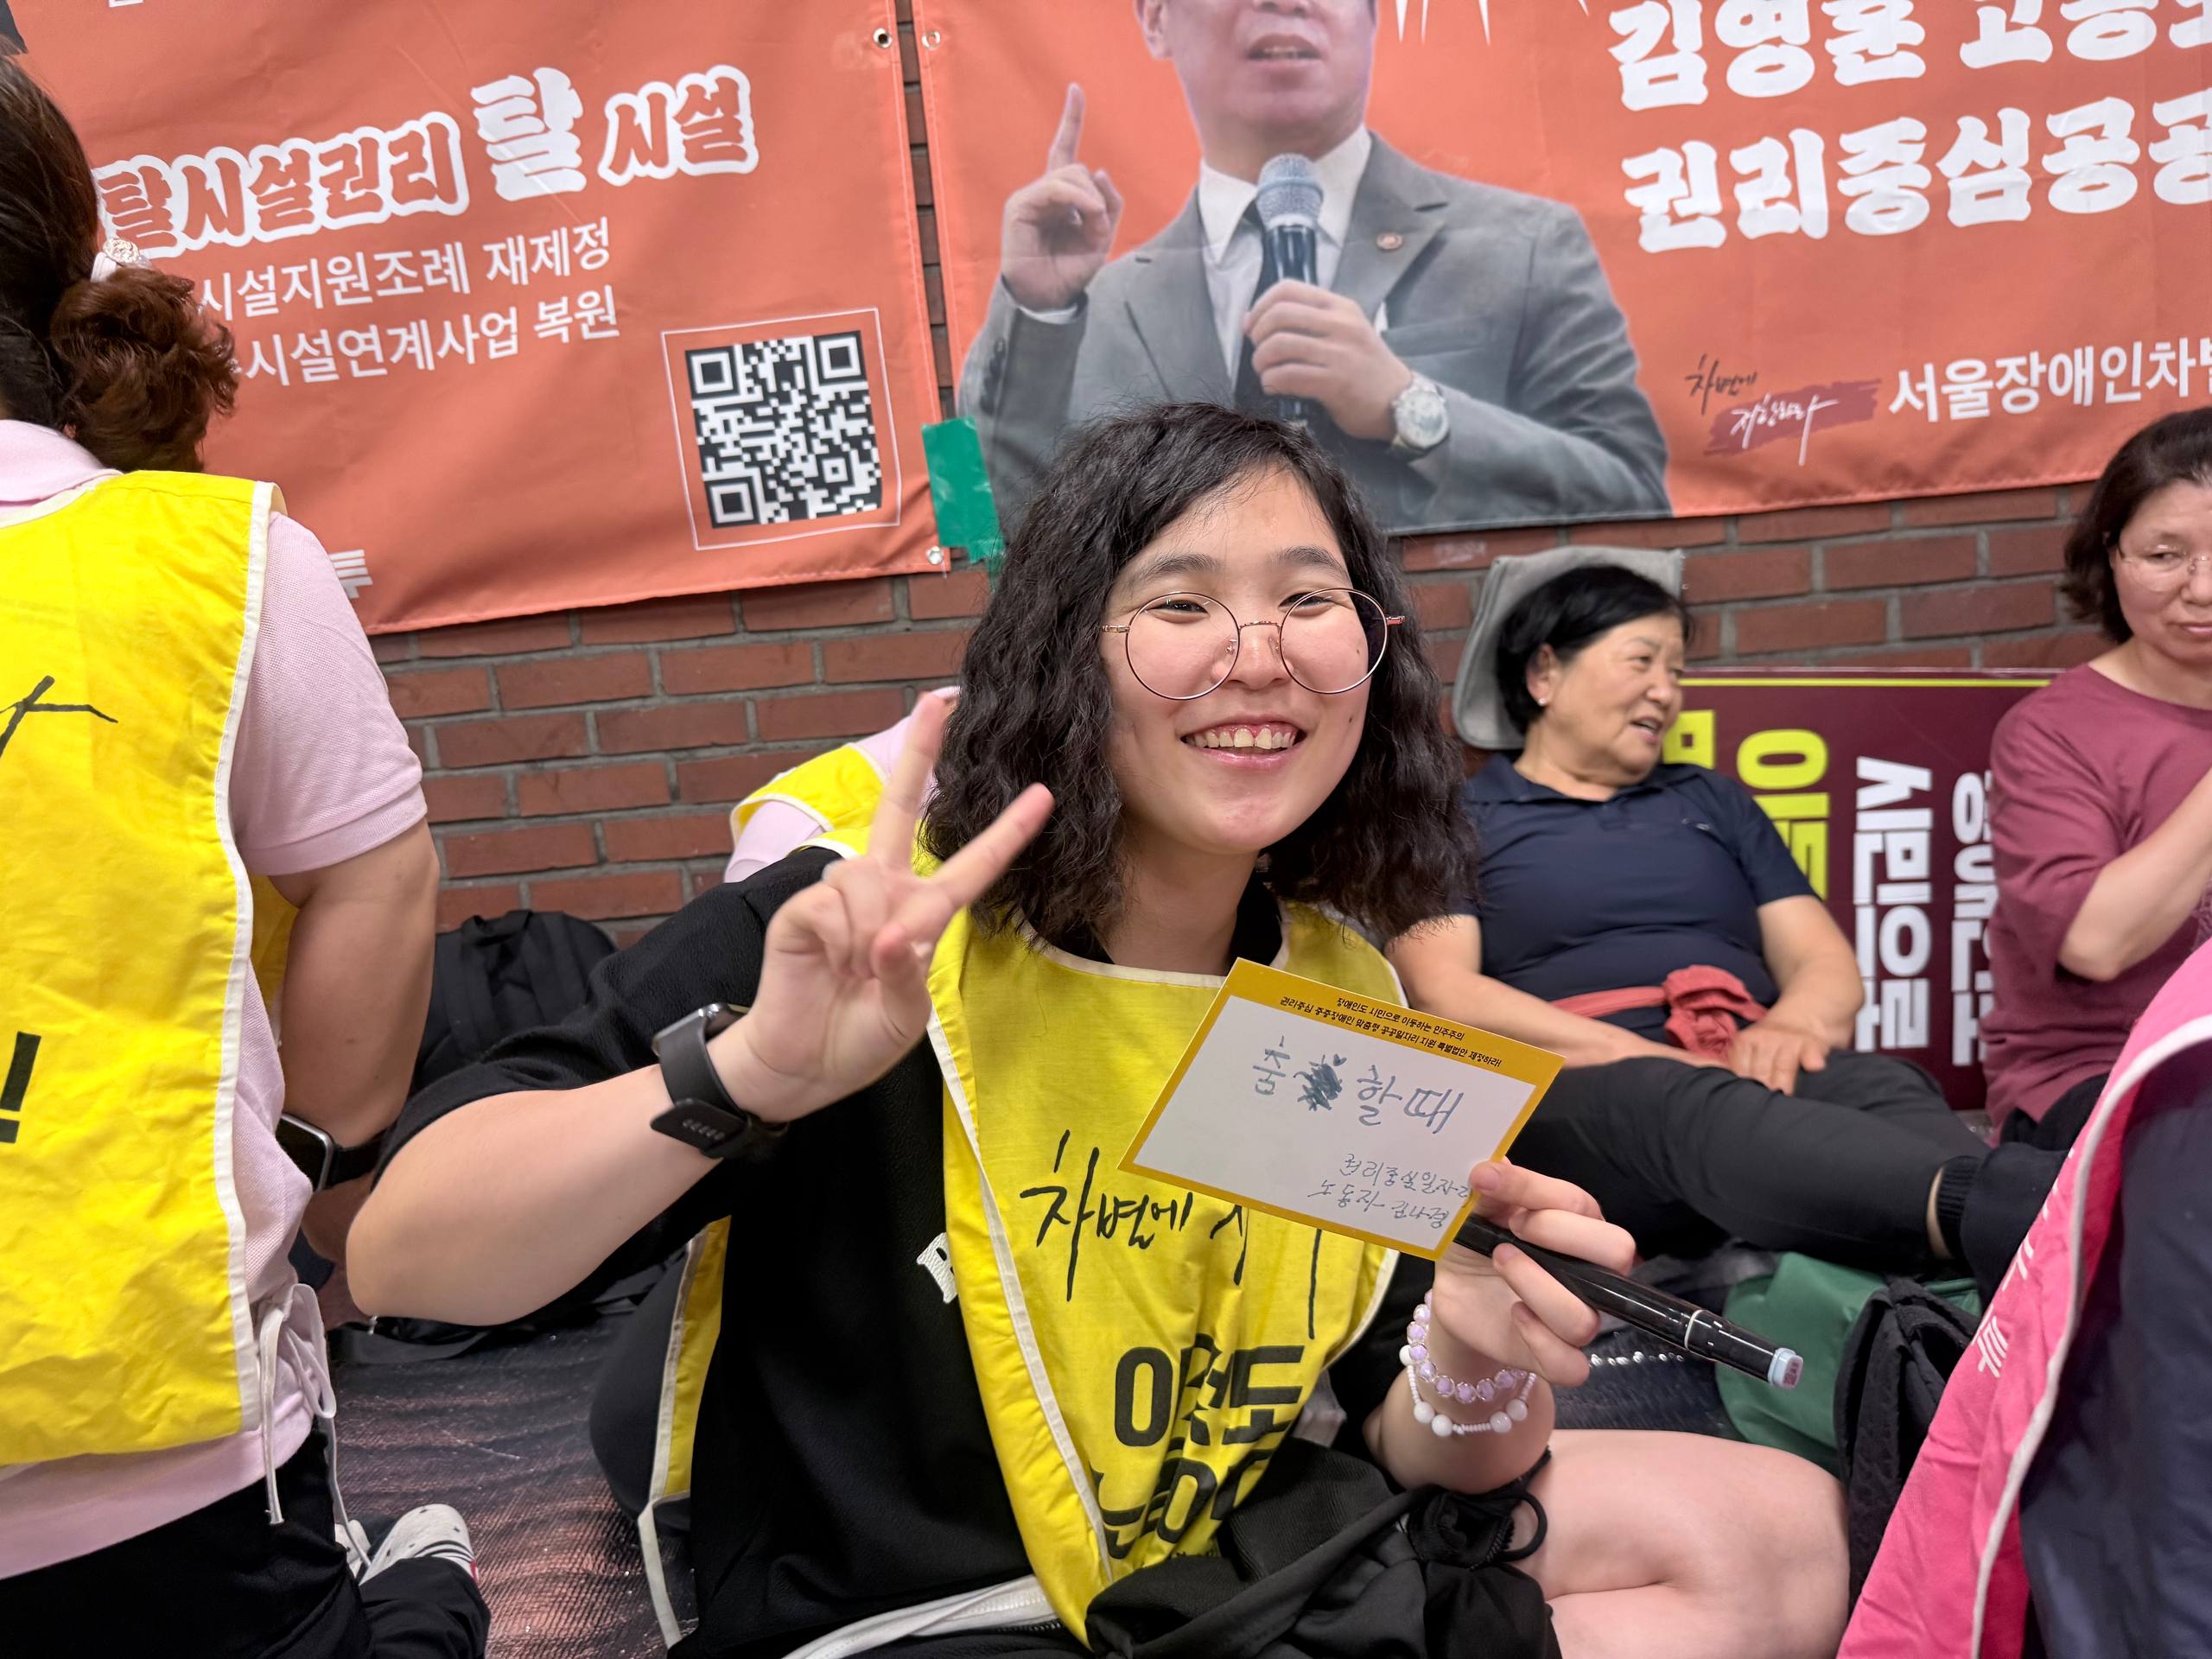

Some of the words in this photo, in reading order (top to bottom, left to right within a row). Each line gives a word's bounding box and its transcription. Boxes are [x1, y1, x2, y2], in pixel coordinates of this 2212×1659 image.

[471, 67, 588, 202] 탈
[597, 64, 760, 187] 시설
[1622, 87, 2212, 254] 권리중심공공
[484, 217, 610, 287] 재제정
[532, 283, 621, 344] 복원
[1888, 337, 2212, 423] 서울장애인차
[1853, 755, 1934, 1052] 시민으로
[1280, 996, 1313, 1014] 권리중심
[1381, 1026, 1420, 1044] 공공일자리
[1420, 1037, 1437, 1049] 지원
[1337, 997, 1369, 1014] 장애인도
[1369, 1007, 1401, 1023] 시민으로
[1402, 1016, 1432, 1033] 이동하는
[1433, 1025, 1465, 1040] 민주주의
[1307, 1179, 1385, 1212] 노동자
